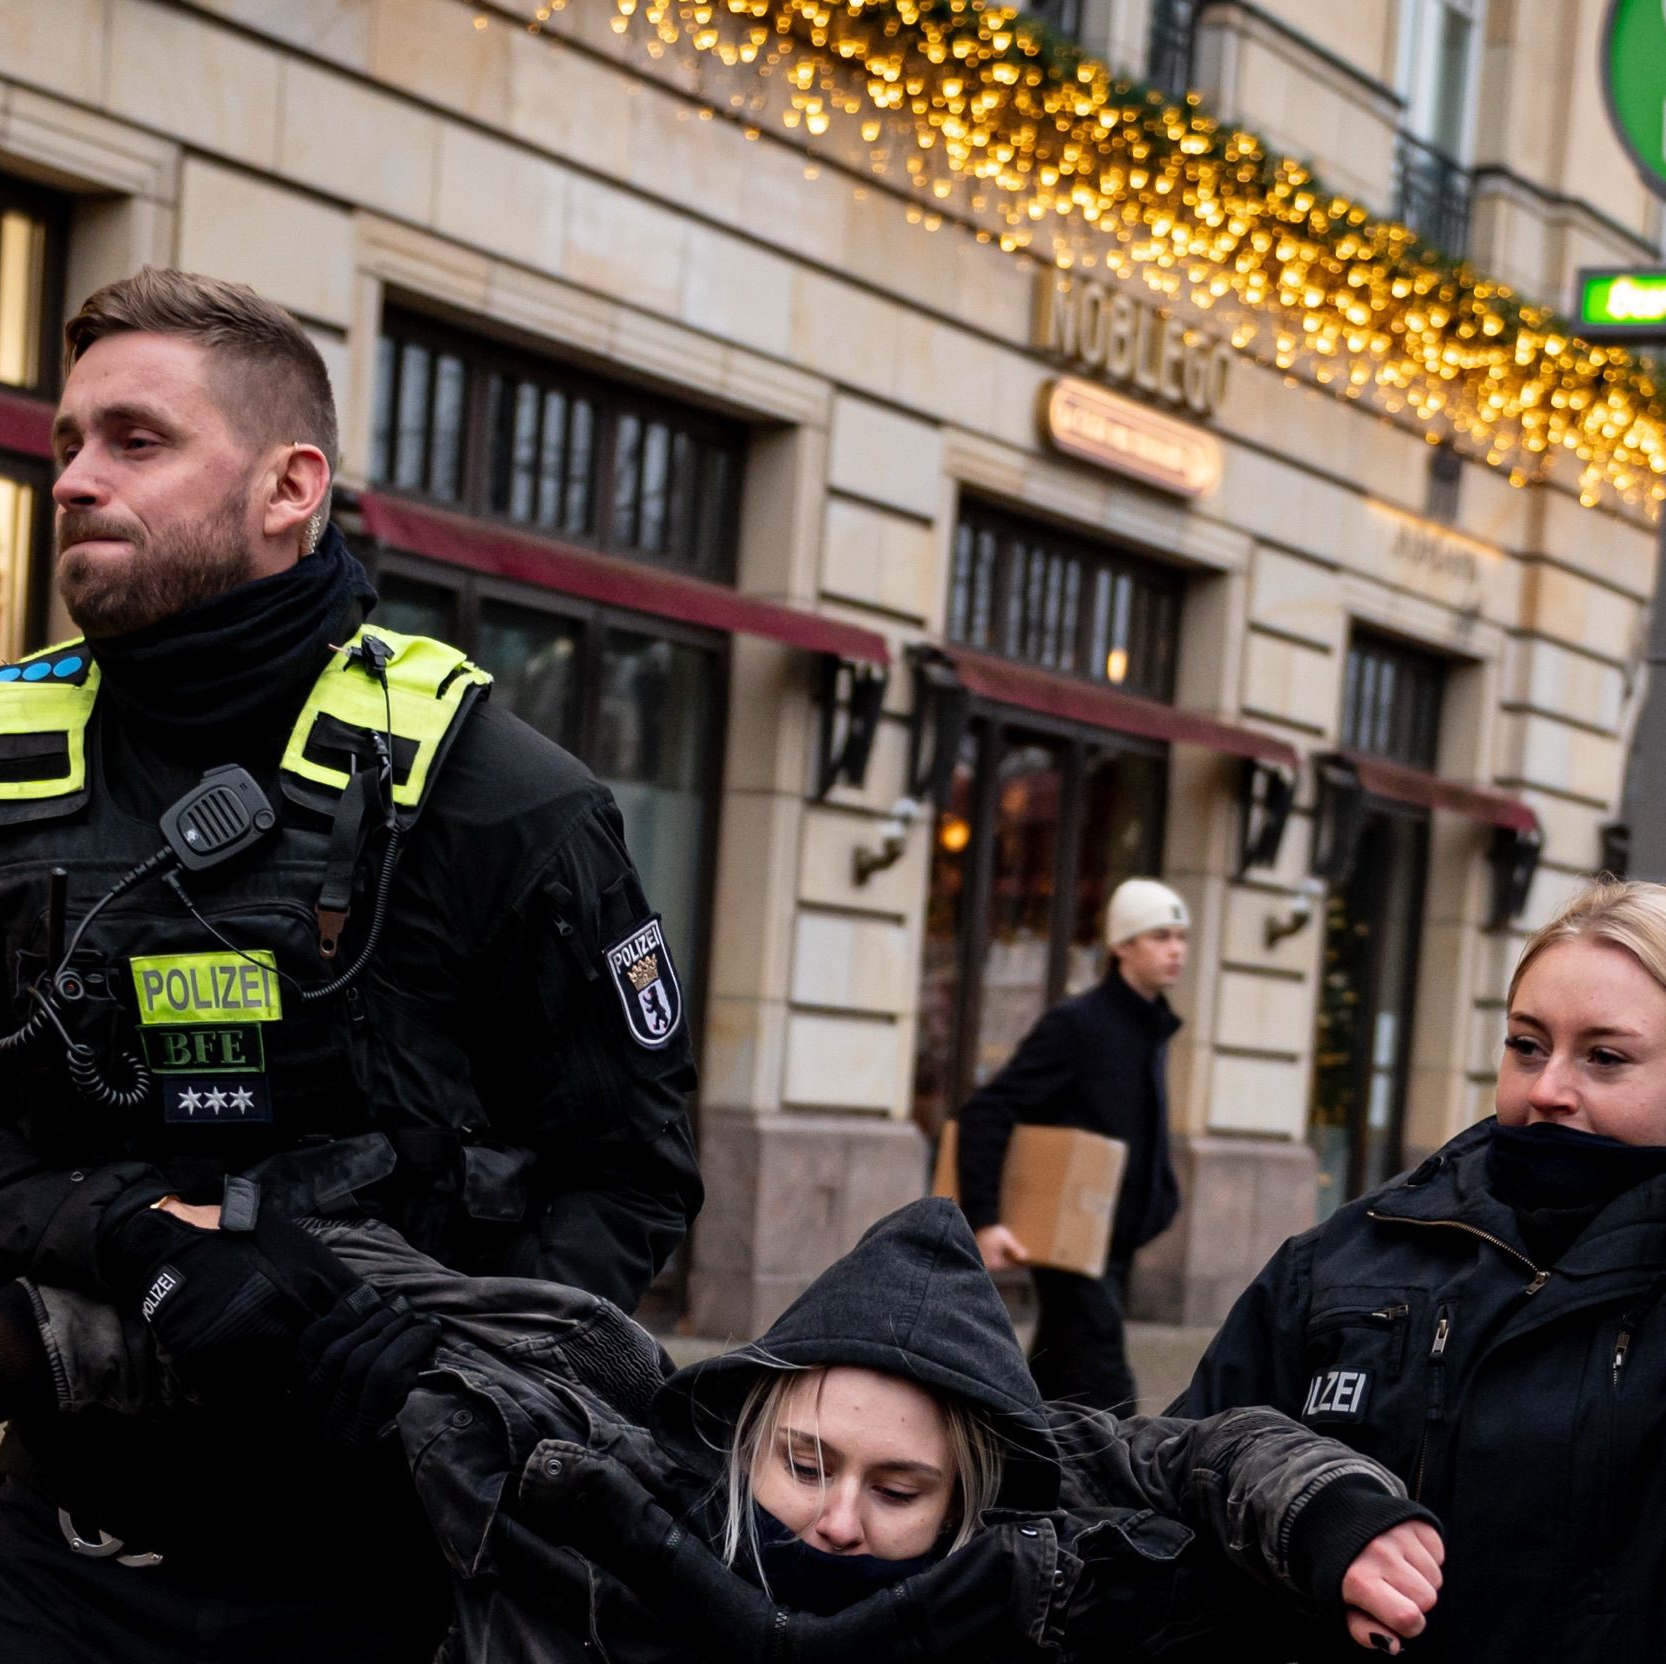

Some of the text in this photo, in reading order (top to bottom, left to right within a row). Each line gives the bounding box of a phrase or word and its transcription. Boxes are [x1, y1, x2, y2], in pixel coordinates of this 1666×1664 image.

[612, 926, 662, 975] POLIZEI
[142, 965, 271, 1012] POLIZEI
[159, 1031, 246, 1065] BFE
